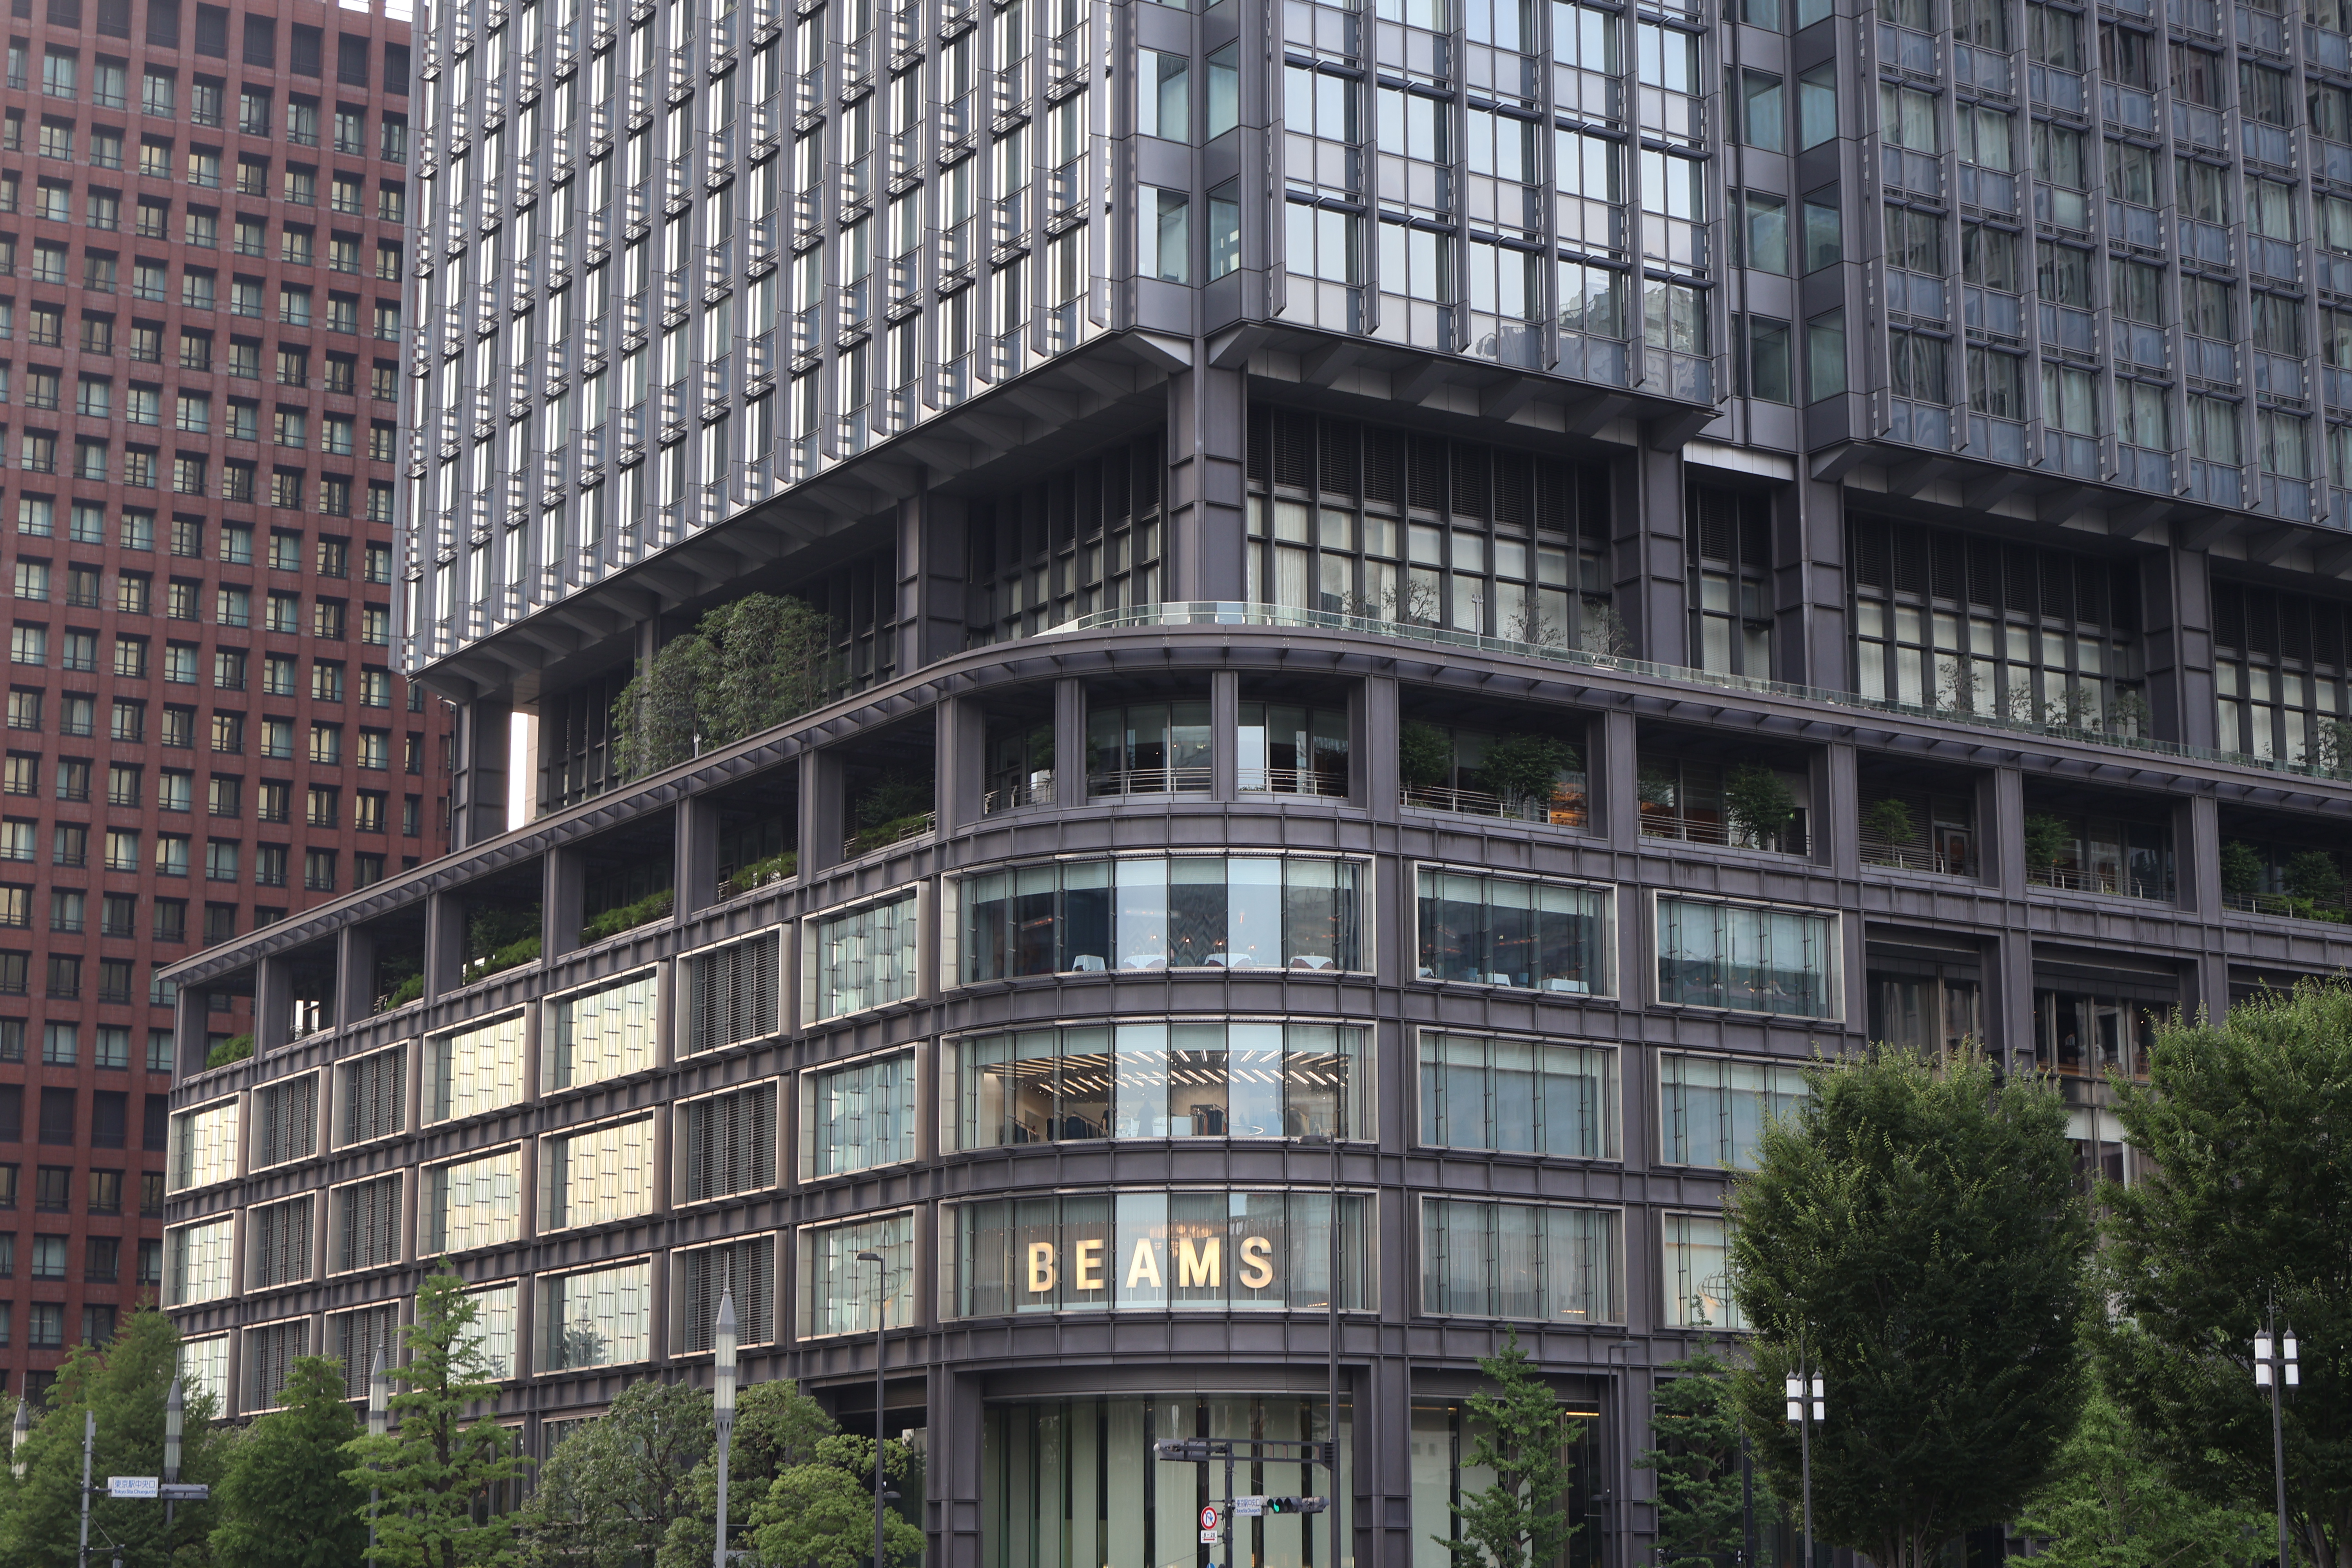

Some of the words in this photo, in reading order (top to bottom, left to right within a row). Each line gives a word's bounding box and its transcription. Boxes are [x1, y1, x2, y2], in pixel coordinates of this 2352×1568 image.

[1028, 1236, 1273, 1293] BEAMS
[115, 1480, 155, 1488] 東京駅中央口
[1237, 1499, 1260, 1507] 東京駅中央口
